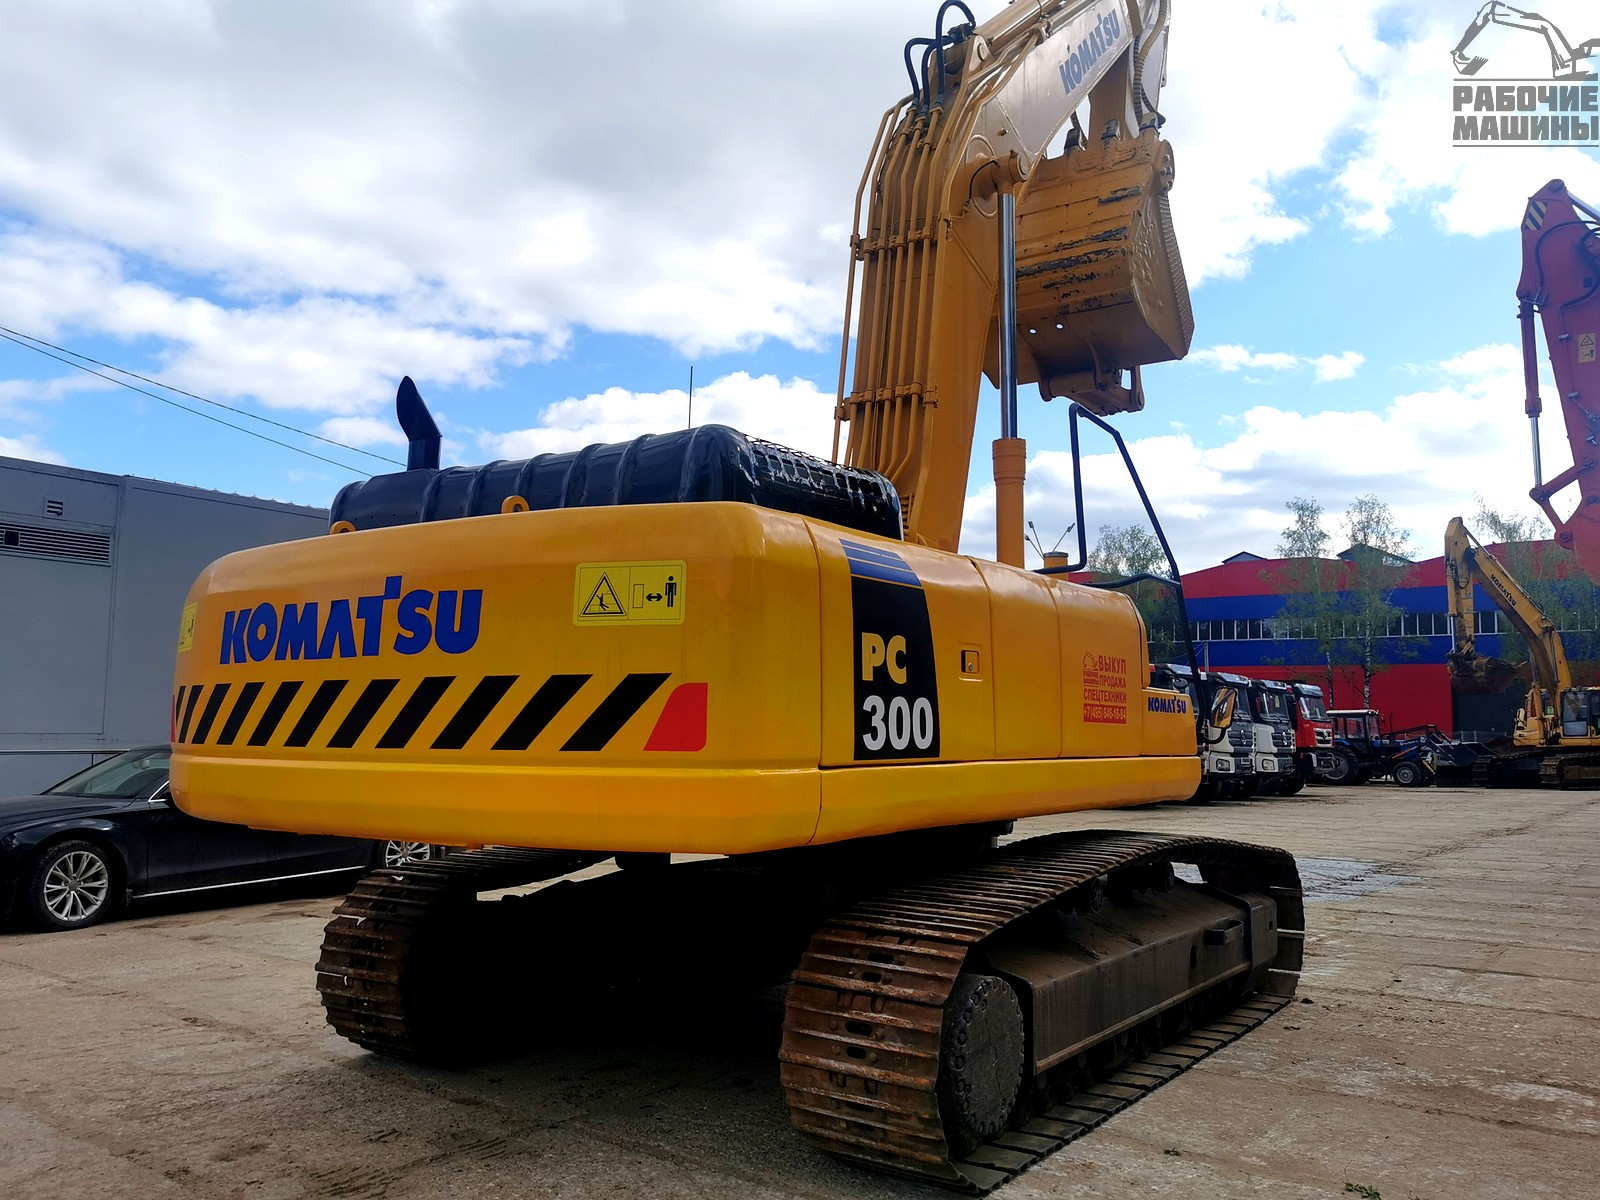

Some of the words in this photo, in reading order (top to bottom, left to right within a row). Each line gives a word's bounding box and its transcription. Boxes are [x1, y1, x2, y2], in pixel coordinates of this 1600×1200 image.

[1059, 8, 1120, 95] KOMATSU
[1490, 573, 1516, 606] KOMATSU
[219, 575, 483, 665] KOMATSU
[861, 632, 907, 684] PC
[1098, 655, 1126, 675] ВЫКУП
[1083, 688, 1126, 703] СПЕЦТЕХНИКИ
[1099, 675, 1126, 689] ПРОДАЖА
[1147, 695, 1186, 714] KOMATSU
[862, 695, 934, 750] 300
